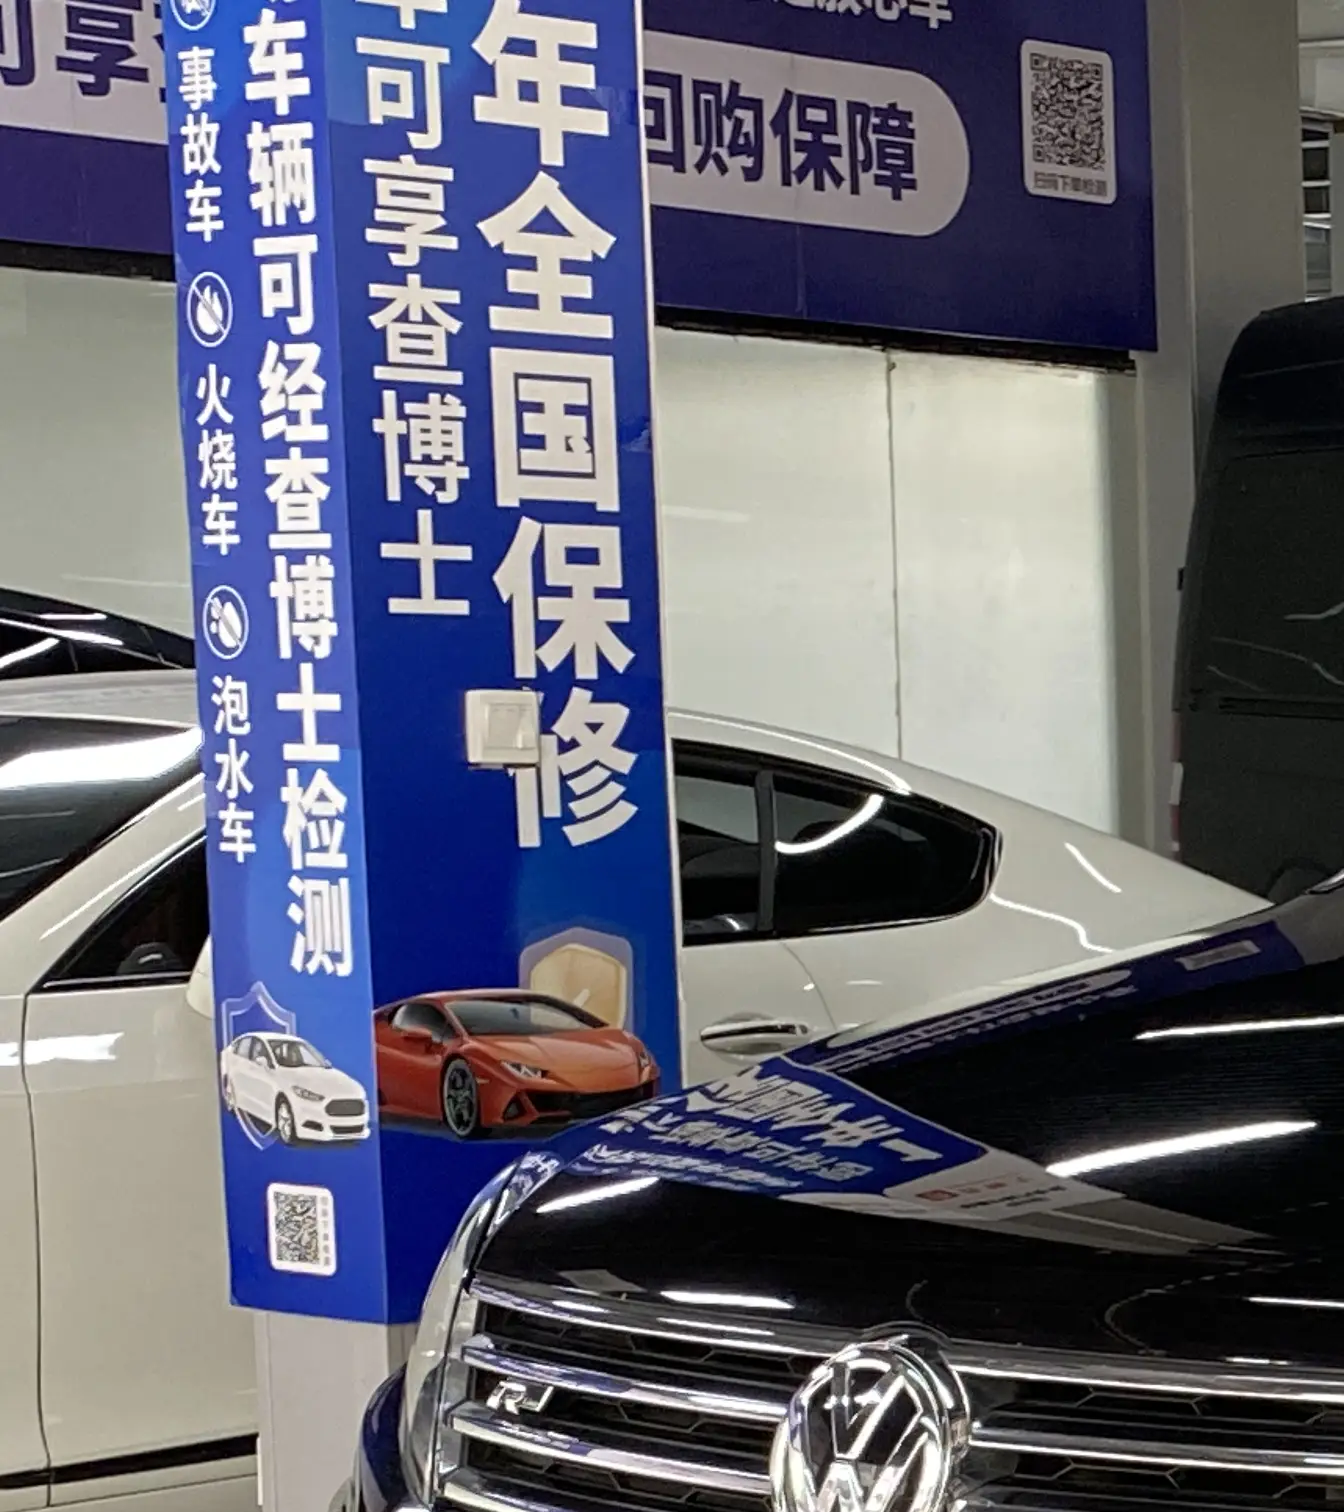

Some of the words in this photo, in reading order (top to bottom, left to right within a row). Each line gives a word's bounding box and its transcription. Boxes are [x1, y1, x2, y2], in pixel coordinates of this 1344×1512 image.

[178, 46, 224, 242] 事故车
[643, 68, 917, 201] 回购保障
[195, 363, 240, 556] 火烧车
[243, 0, 353, 977] 车辆可经查博士检测
[471, 0, 640, 848] 年全国保修
[211, 675, 256, 863] 泡水车
